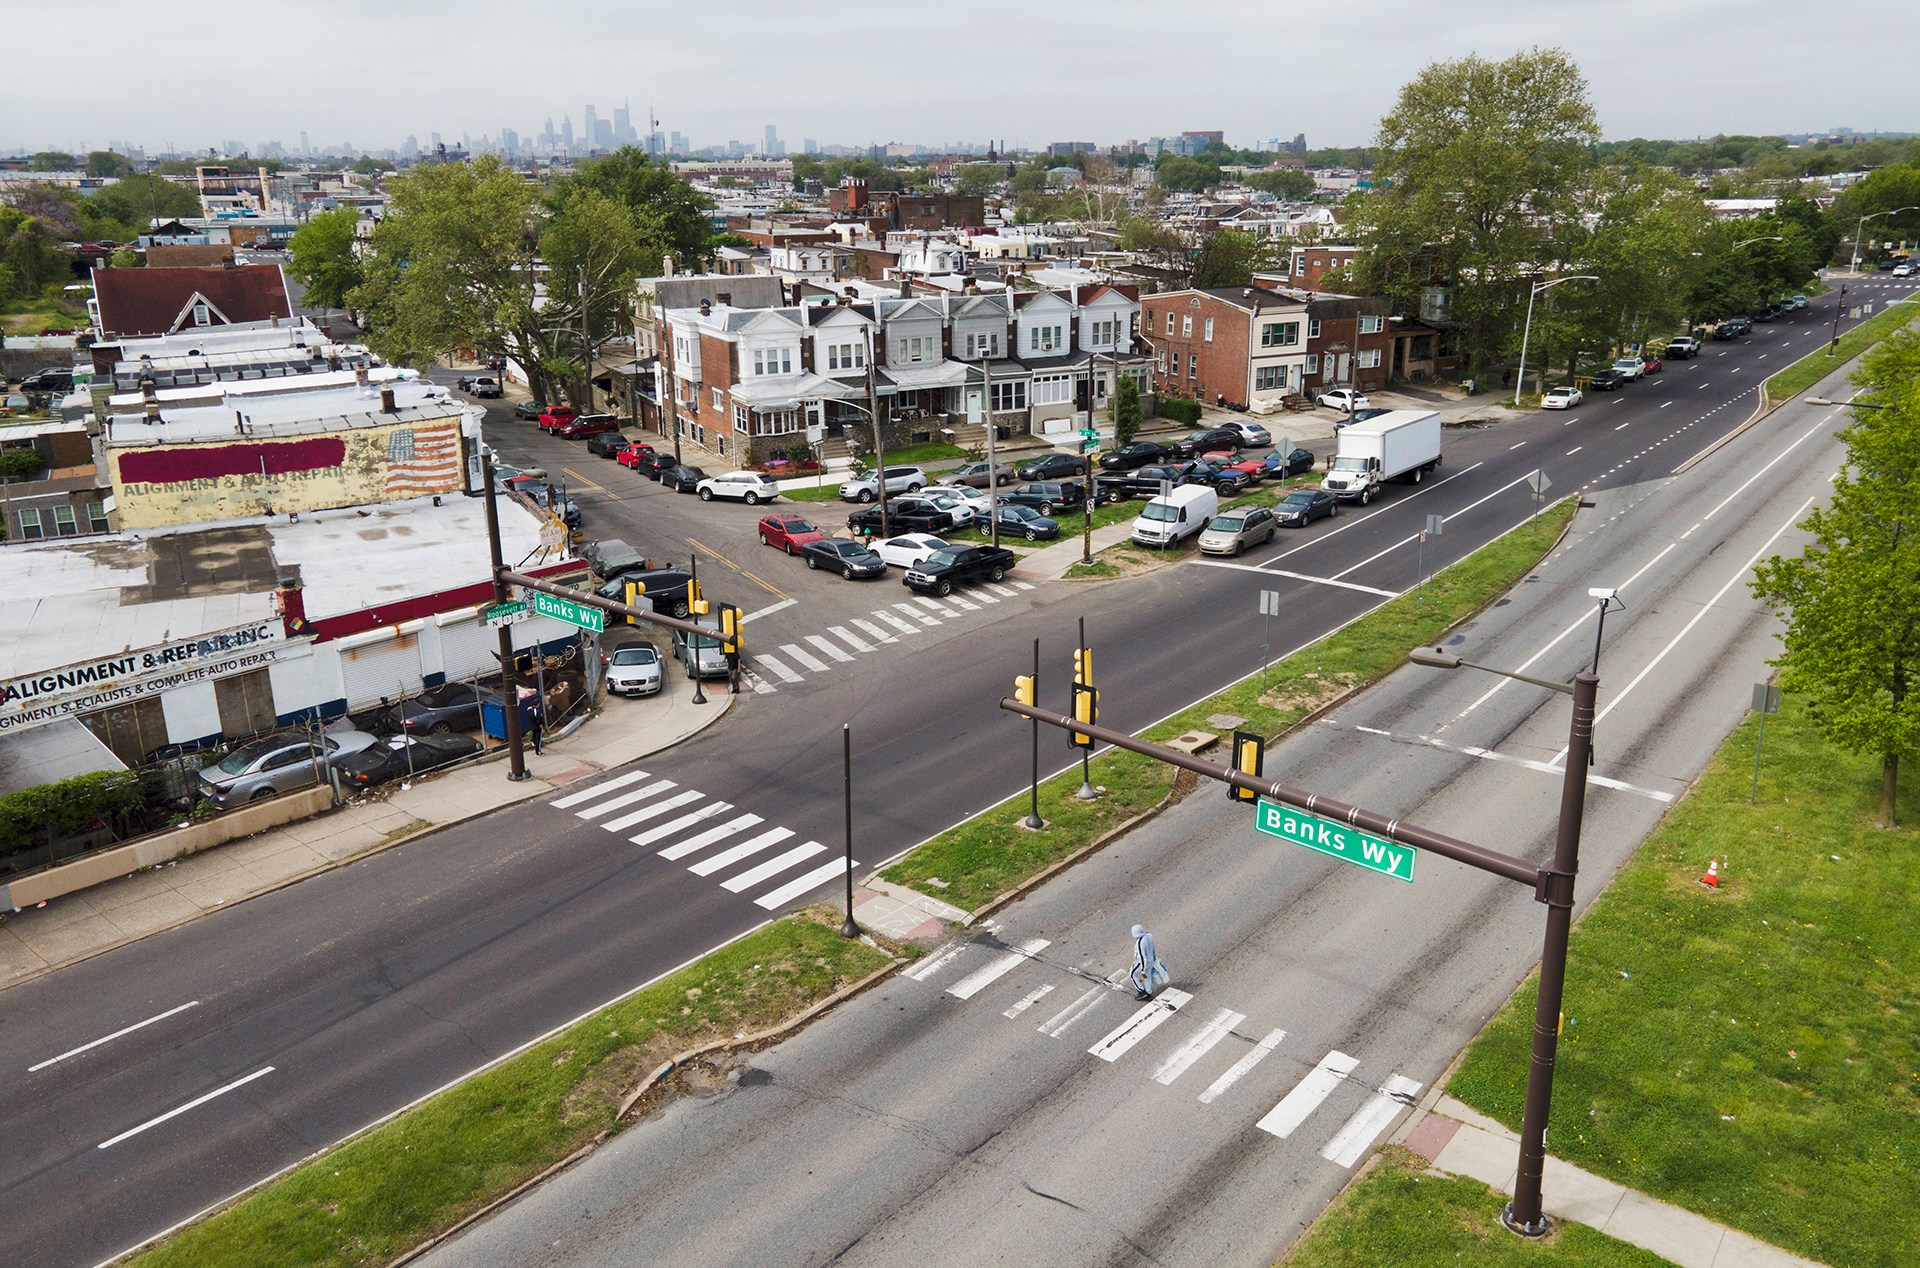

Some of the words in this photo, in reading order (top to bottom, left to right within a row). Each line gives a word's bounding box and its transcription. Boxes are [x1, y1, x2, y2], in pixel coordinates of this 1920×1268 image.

[123, 477, 219, 497] ALIGNMENT
[224, 476, 237, 488] &
[291, 466, 352, 482] REPAIR
[486, 605, 518, 619] Roosevelt
[539, 597, 574, 619] Banks
[579, 608, 598, 629] Wy
[5, 657, 136, 702] ALIGNMENT
[142, 653, 156, 669] &
[61, 686, 132, 712] SECIALISTS
[135, 683, 144, 694] &
[146, 668, 205, 690] COMPLETE
[208, 659, 238, 676] AUTO
[240, 650, 277, 668] REPAR
[1266, 808, 1346, 851] Banks
[1361, 839, 1403, 873] Wy
